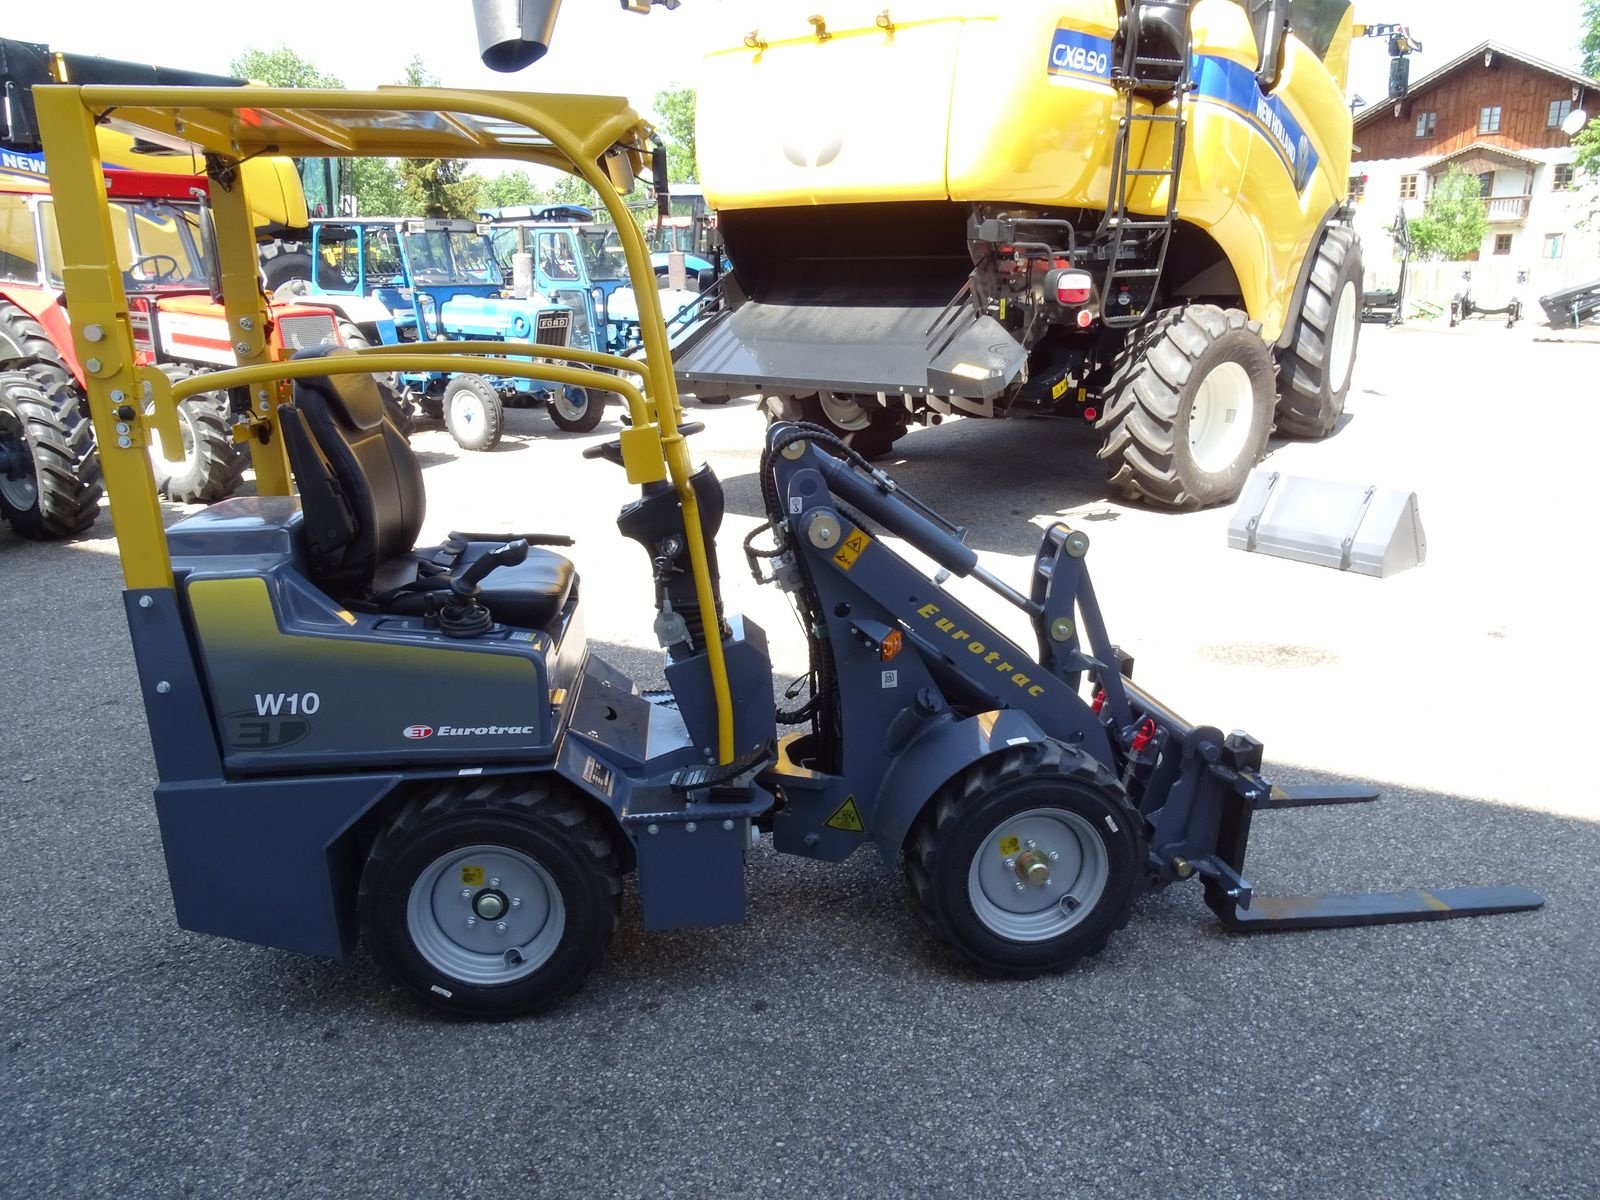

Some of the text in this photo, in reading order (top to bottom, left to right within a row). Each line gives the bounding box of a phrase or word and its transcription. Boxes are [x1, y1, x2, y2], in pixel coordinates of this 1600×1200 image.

[1256, 97, 1296, 164] NEW HOLLAND
[2, 153, 46, 174] NEW
[542, 319, 565, 327] FORD
[916, 603, 1045, 697] Eurotrac
[254, 692, 320, 716] W10
[437, 726, 534, 736] Eurotrac
